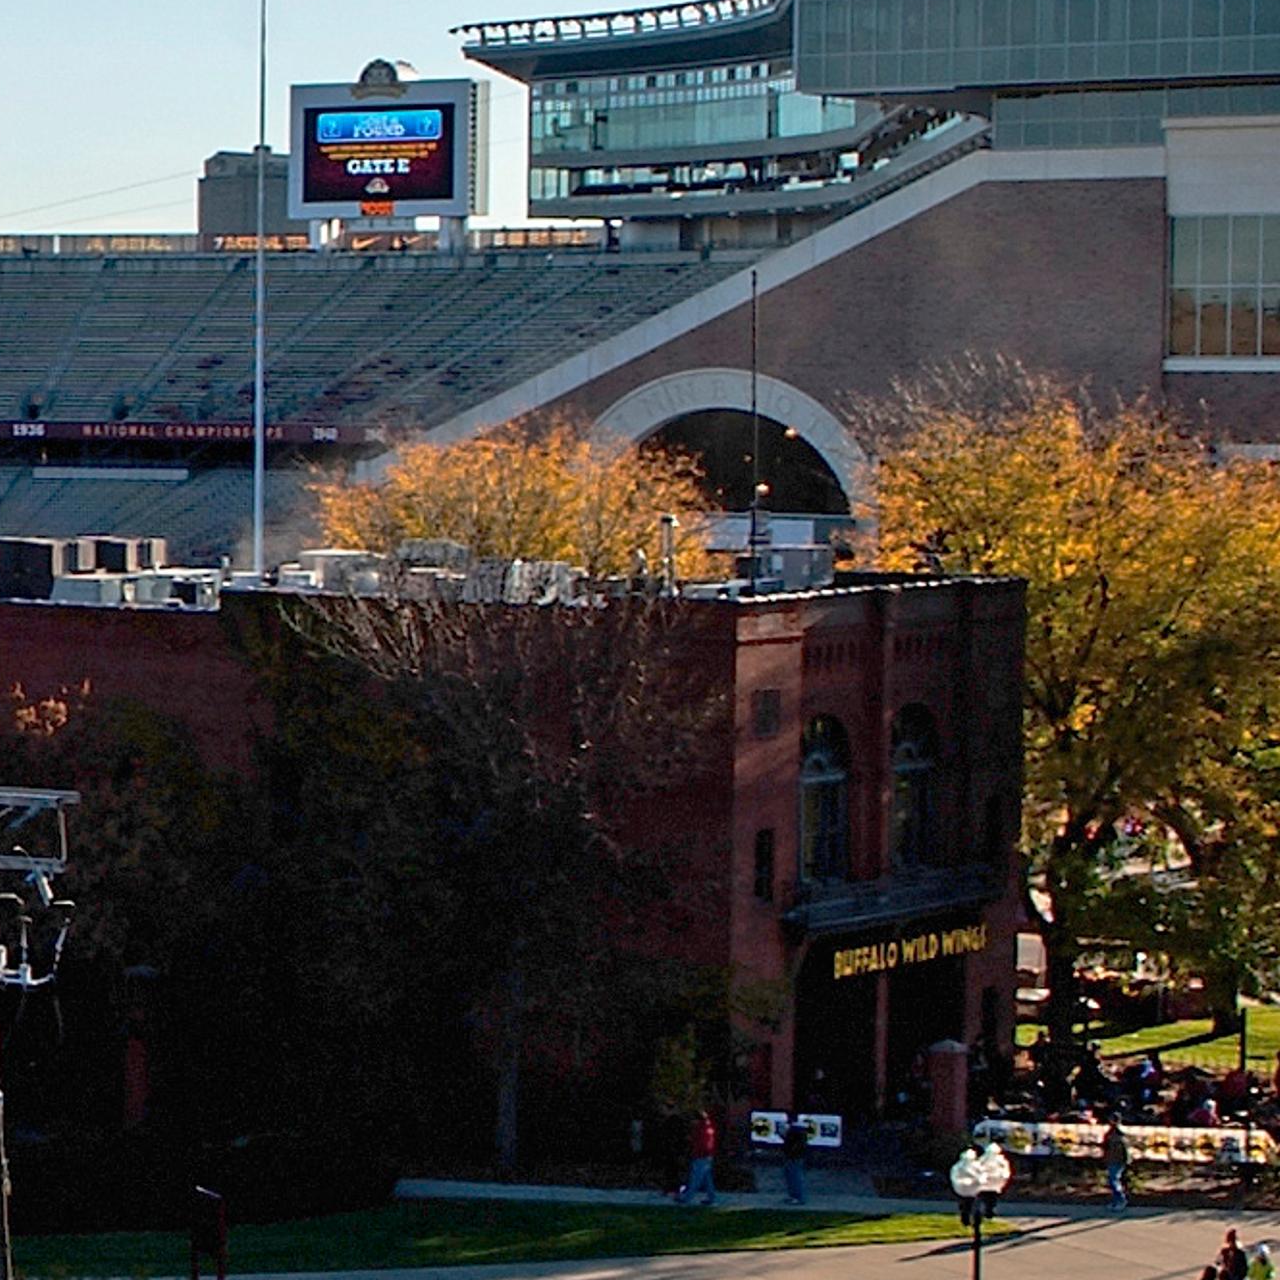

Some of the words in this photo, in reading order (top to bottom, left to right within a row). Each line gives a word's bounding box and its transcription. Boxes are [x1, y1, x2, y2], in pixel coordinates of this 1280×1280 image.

[346, 158, 395, 175] GATE
[397, 158, 411, 173] E
[82, 425, 156, 438] NATIONAL
[833, 941, 899, 980] BUFFALO
[901, 932, 939, 965] WILD
